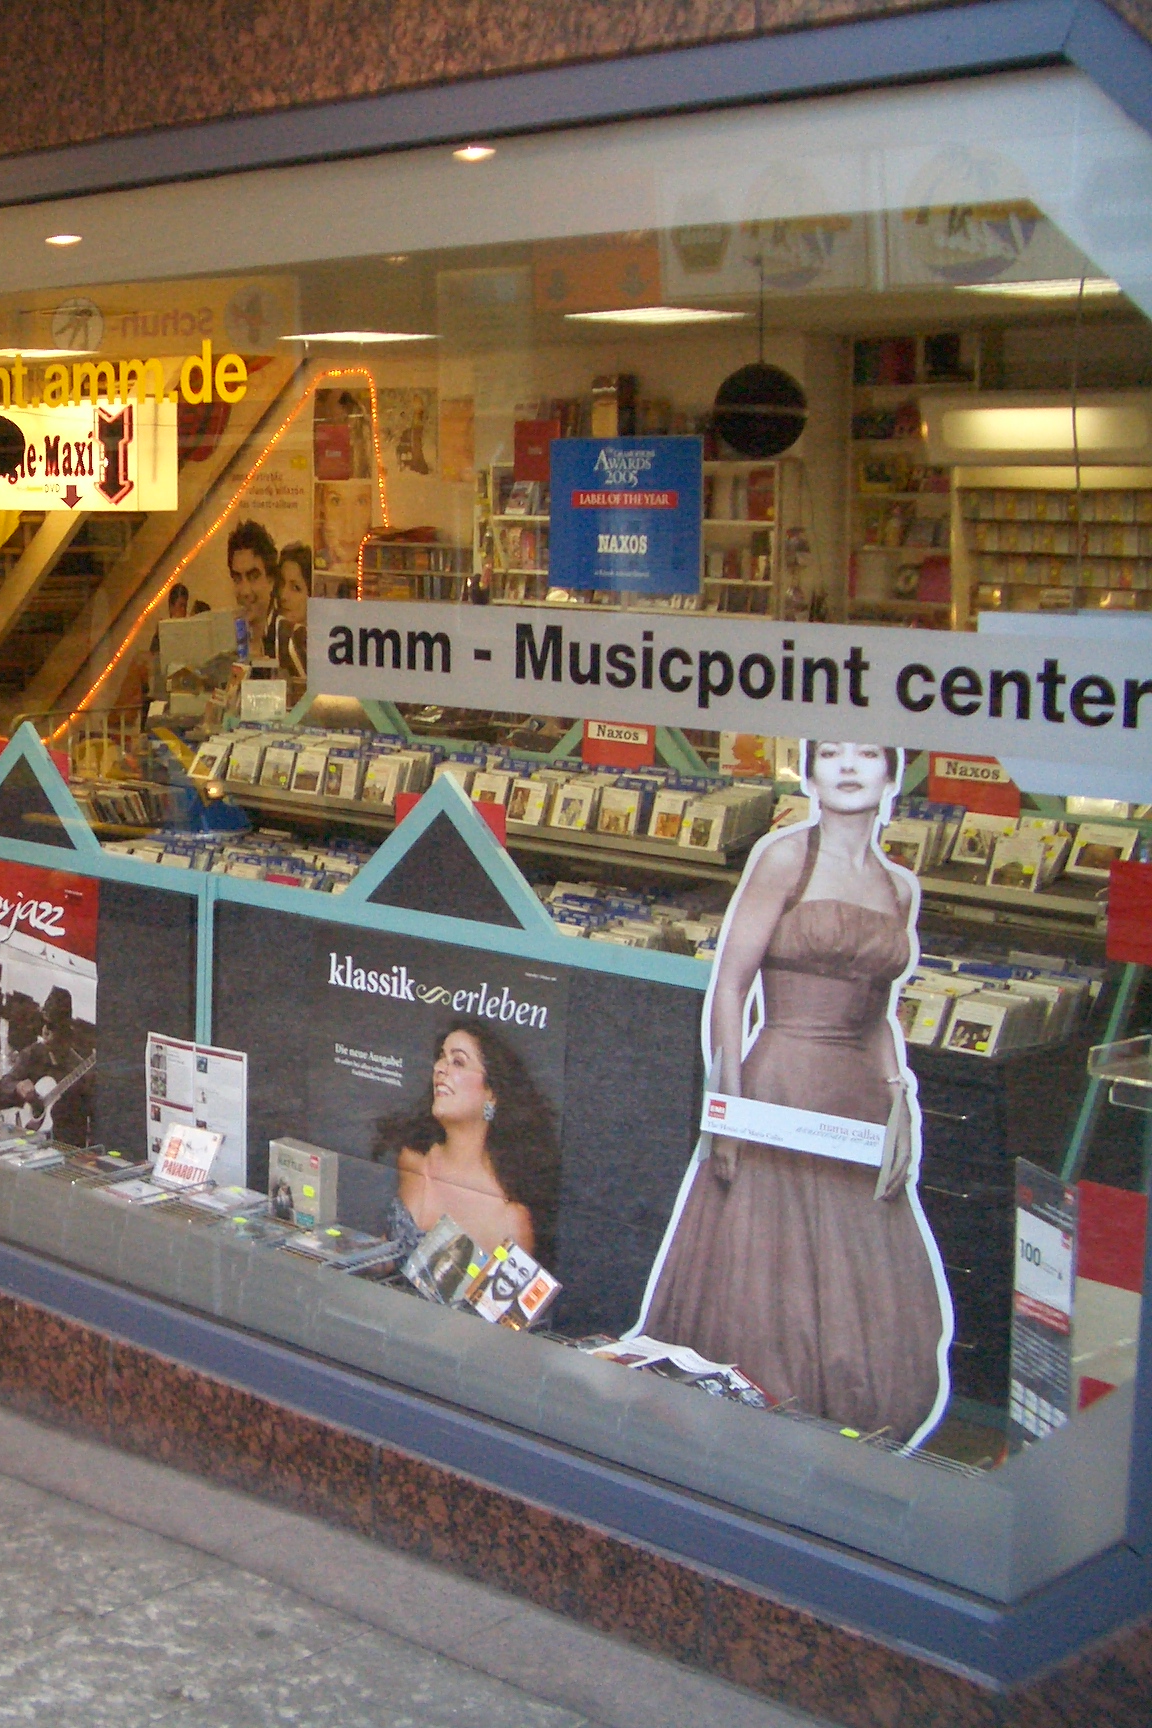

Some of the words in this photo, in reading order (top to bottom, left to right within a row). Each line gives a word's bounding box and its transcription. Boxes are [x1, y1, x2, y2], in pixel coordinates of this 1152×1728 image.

[579, 493, 607, 505] LABEL
[608, 494, 621, 505] OF
[623, 494, 643, 505] THE
[643, 494, 670, 505] YEAR
[598, 534, 648, 554] NAXOS
[327, 624, 451, 673] amm
[515, 622, 870, 708] Musicpoint
[596, 724, 639, 742] Naxos
[945, 760, 1000, 780] Naxos
[0, 891, 66, 943] jazz
[328, 952, 415, 1001] klassik
[452, 983, 547, 1030] erleben
[161, 1159, 207, 1183] PAVAROTTI
[1020, 1238, 1041, 1267] 100
